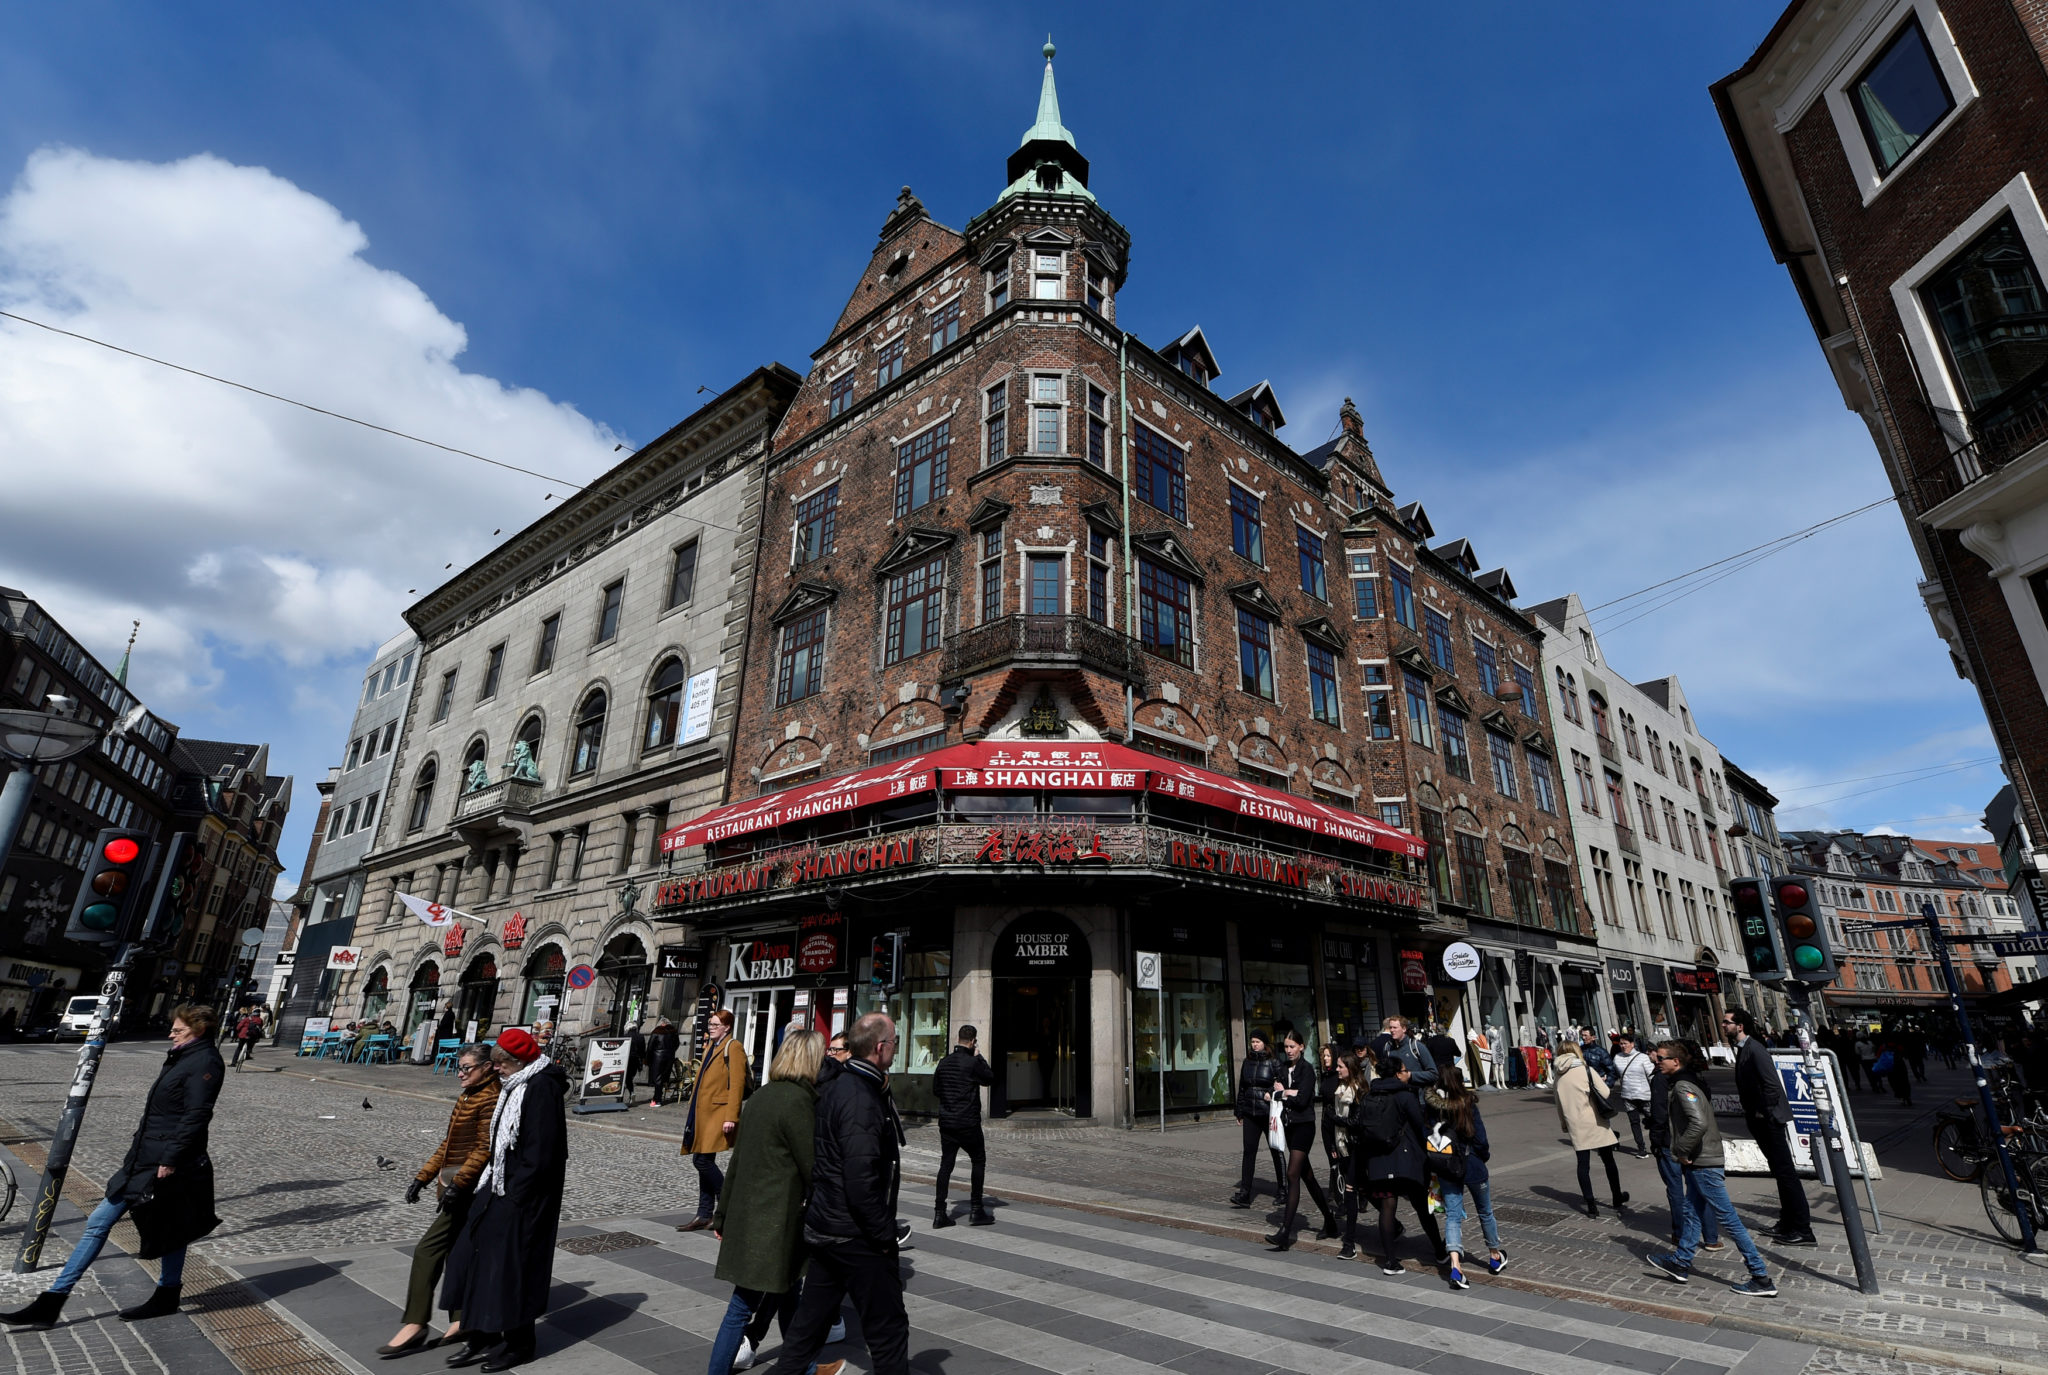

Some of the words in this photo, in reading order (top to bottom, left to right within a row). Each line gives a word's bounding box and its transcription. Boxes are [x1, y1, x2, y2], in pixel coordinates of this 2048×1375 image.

[989, 759, 1102, 767] SHANGHAI
[952, 771, 978, 785] 上海
[984, 771, 1103, 786] SHANGHAI
[1110, 772, 1136, 787] 飯店
[707, 811, 781, 840] RESTAURANT
[786, 792, 858, 820] SHANGHAI
[994, 815, 1096, 830] SHANGHAI
[1240, 799, 1318, 831] RESTAURANT
[1324, 821, 1375, 845] SHANGHAI
[656, 865, 773, 907] RESTAURANT
[791, 837, 915, 883] SHANGHAI
[1170, 840, 1310, 889] RESTAURANT
[1339, 874, 1422, 909] SHANGHAI
[503, 911, 528, 940] MAX
[1746, 919, 1766, 936] 26
[444, 922, 466, 949] MAX
[1015, 933, 1052, 944] HOUSE
[1054, 933, 1070, 943] OF
[801, 940, 835, 953] RESTAURANT
[804, 949, 831, 957] SHANGHAI
[1015, 944, 1070, 957] AMBER
[333, 949, 358, 964] MAX
[664, 955, 698, 969] KEBAB
[725, 942, 794, 983] KEBAB
[1612, 968, 1632, 982] ALDO
